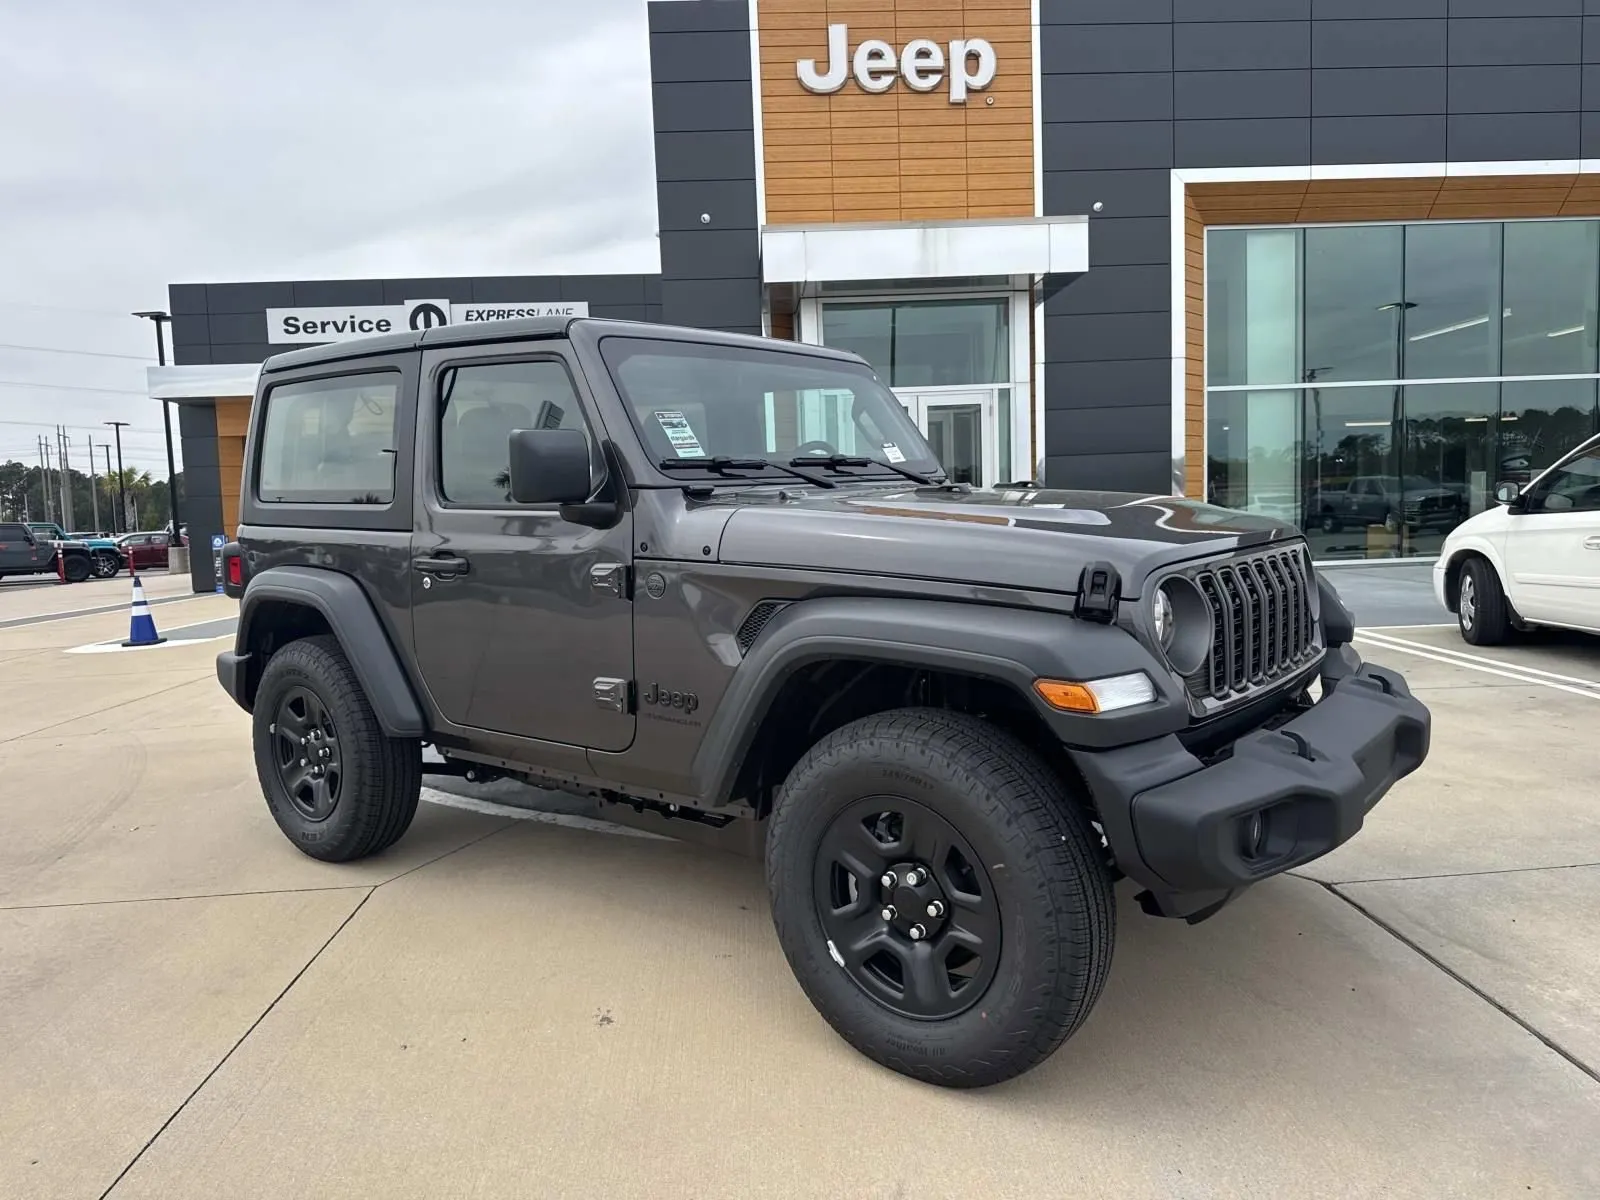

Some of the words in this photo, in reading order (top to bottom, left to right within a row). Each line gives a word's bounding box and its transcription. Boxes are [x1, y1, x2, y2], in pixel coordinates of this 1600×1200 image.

[796, 23, 997, 104] Jeep
[282, 314, 392, 335] Service
[643, 682, 699, 715] Jeep
